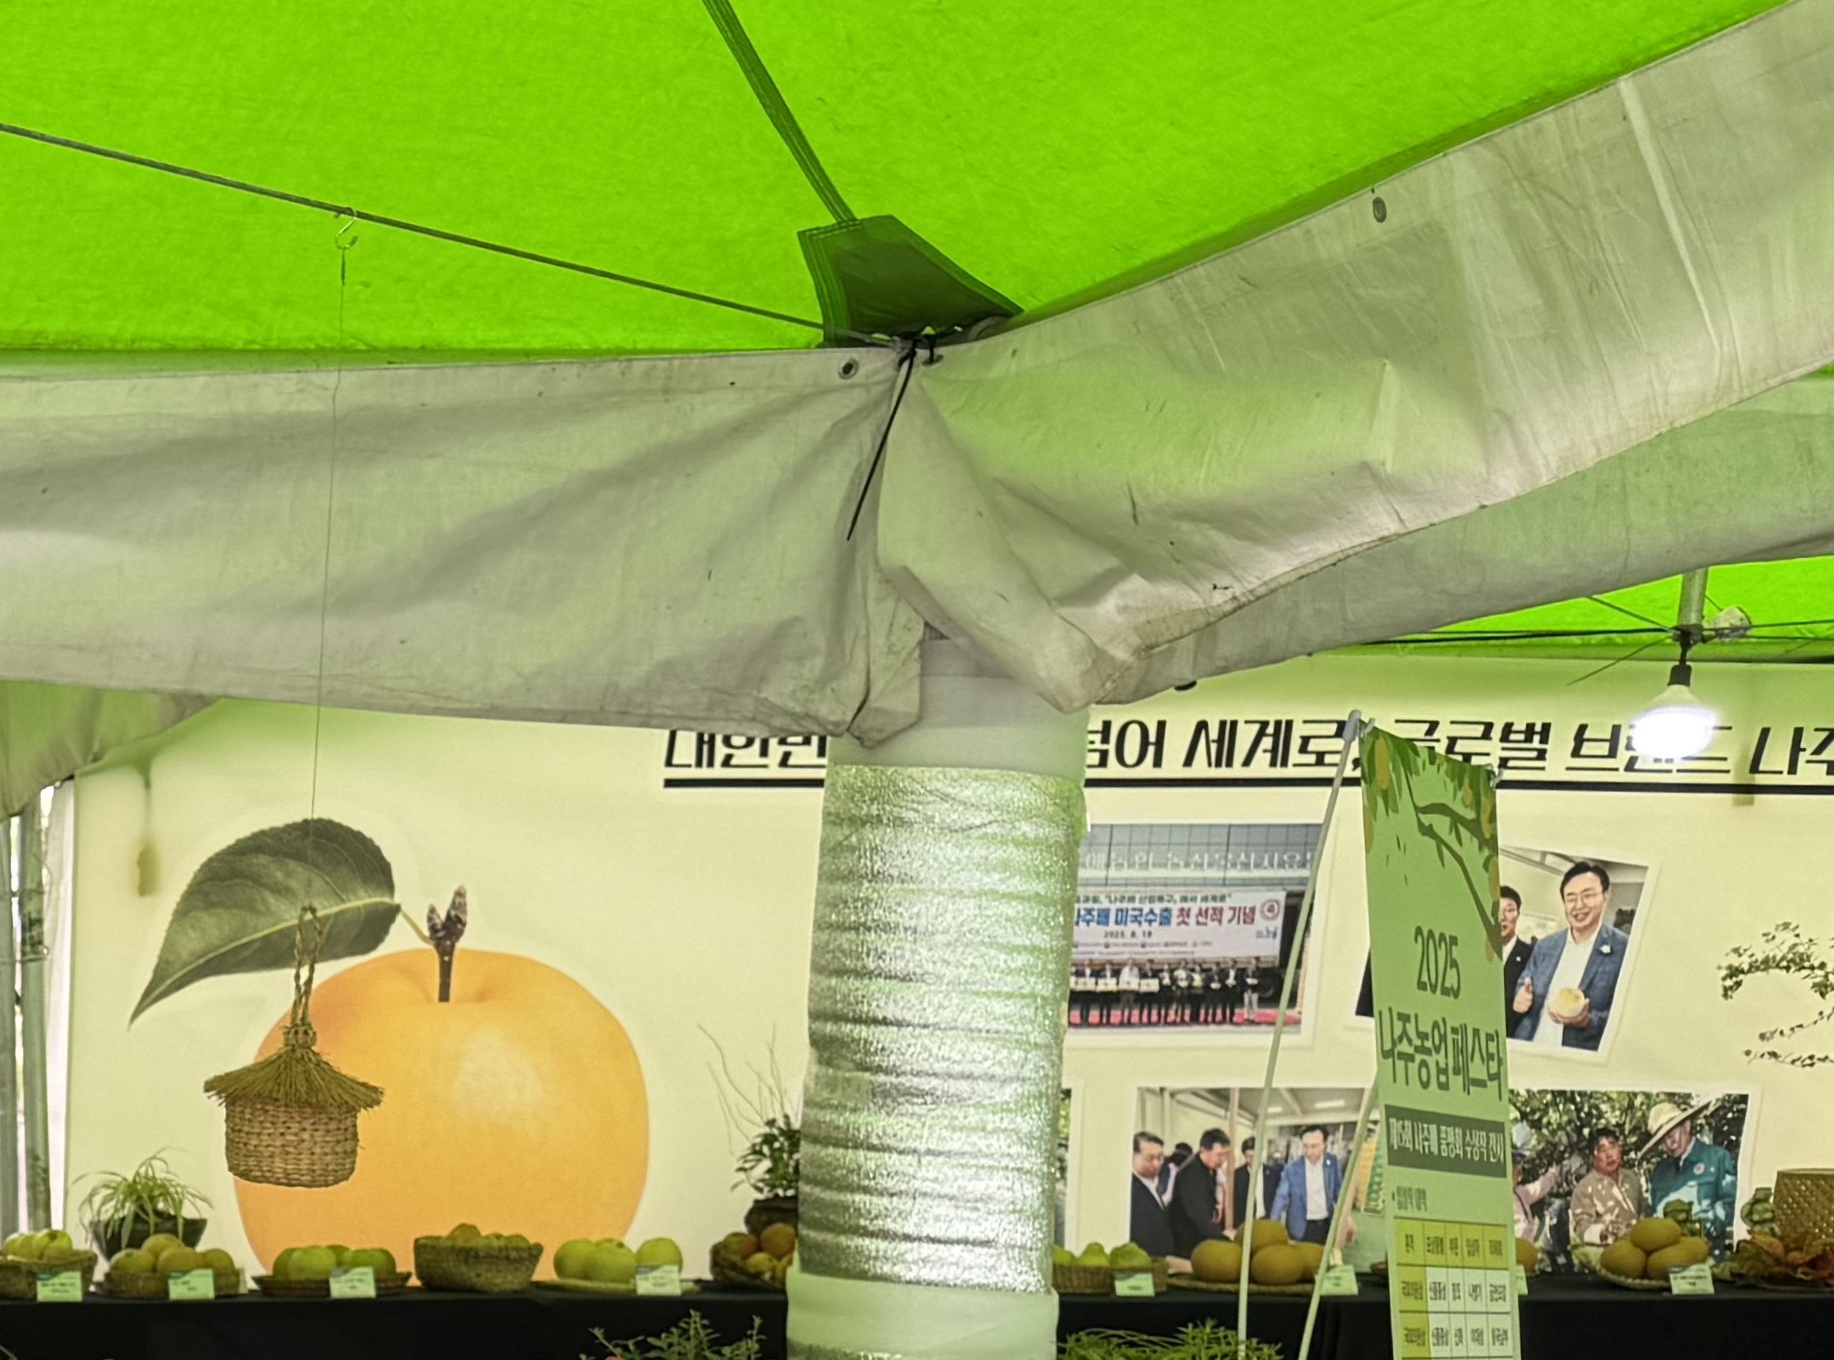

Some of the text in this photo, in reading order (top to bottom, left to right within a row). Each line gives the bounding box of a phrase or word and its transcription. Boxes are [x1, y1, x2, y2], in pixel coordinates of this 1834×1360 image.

[1566, 723, 1733, 774] 브드
[1114, 906, 1173, 927] 미국수출
[1176, 906, 1192, 927] 첫
[1195, 905, 1224, 927] 선적
[1227, 904, 1257, 926] 기념
[1414, 925, 1462, 1000] 2025
[1414, 1121, 1438, 1157] 나주배
[1440, 1125, 1463, 1159] 품평회
[1465, 1129, 1487, 1162] 수상작
[1489, 1131, 1505, 1164] 전시
